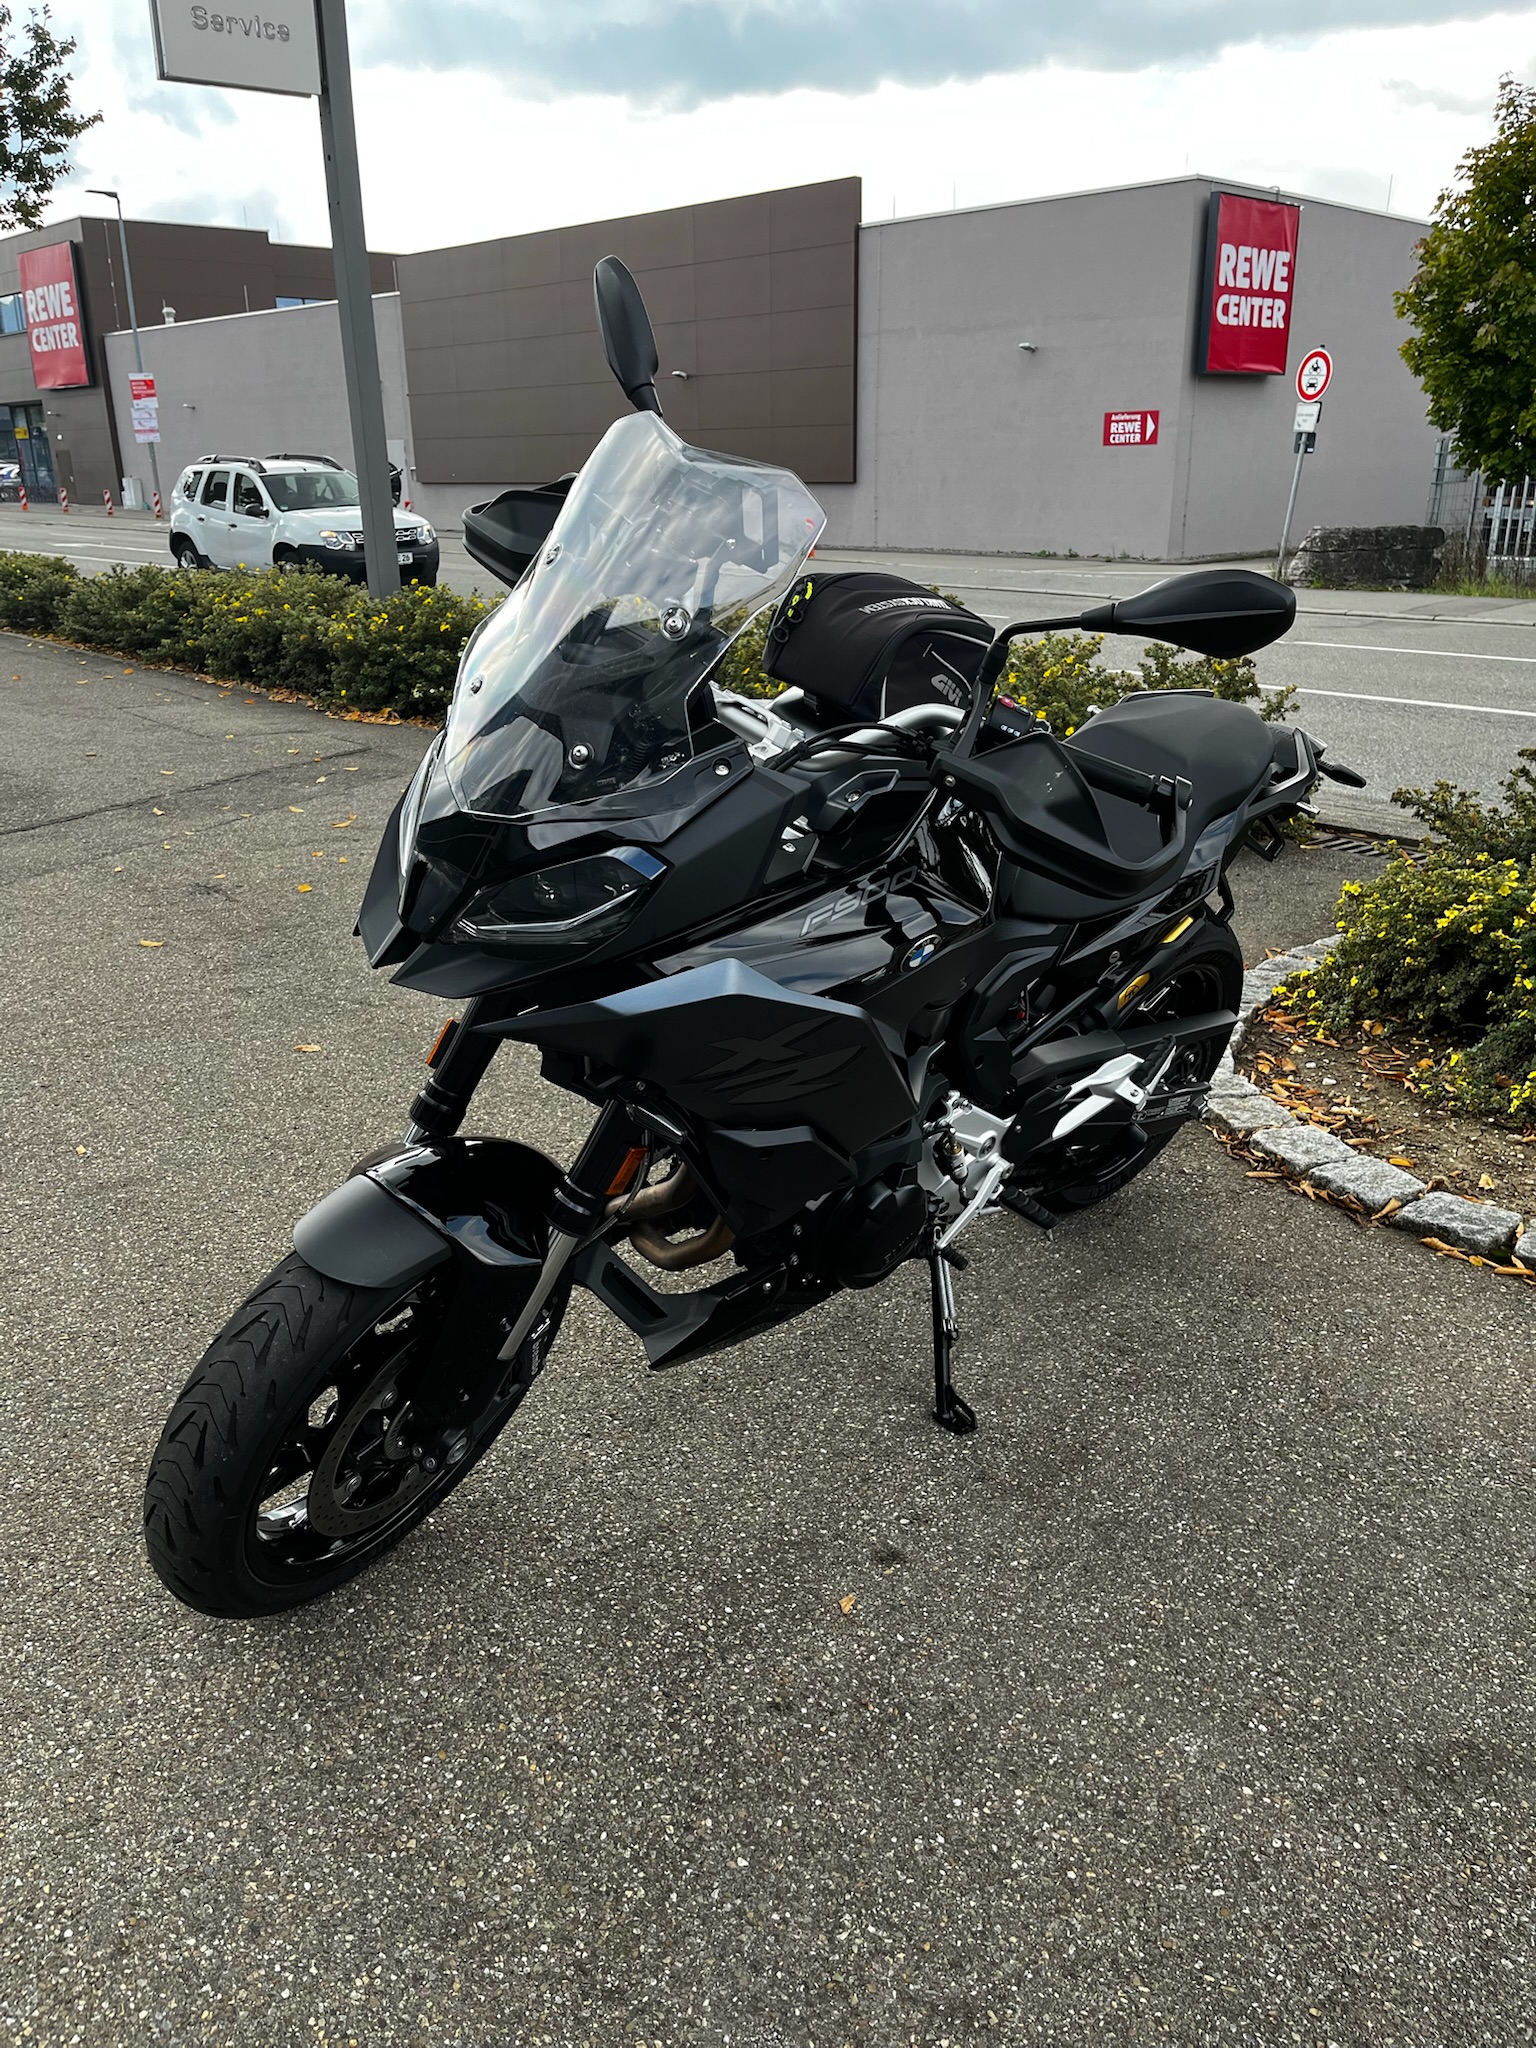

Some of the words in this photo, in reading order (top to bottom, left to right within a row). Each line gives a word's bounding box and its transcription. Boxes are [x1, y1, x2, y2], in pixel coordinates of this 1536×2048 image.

[190, 5, 290, 42] Service
[1218, 243, 1291, 293] REWE
[25, 281, 75, 323] REWE
[1216, 293, 1286, 329] CENTER
[31, 322, 80, 353] CENTER
[1110, 421, 1141, 433] REWE
[1110, 433, 1141, 444] CENTER
